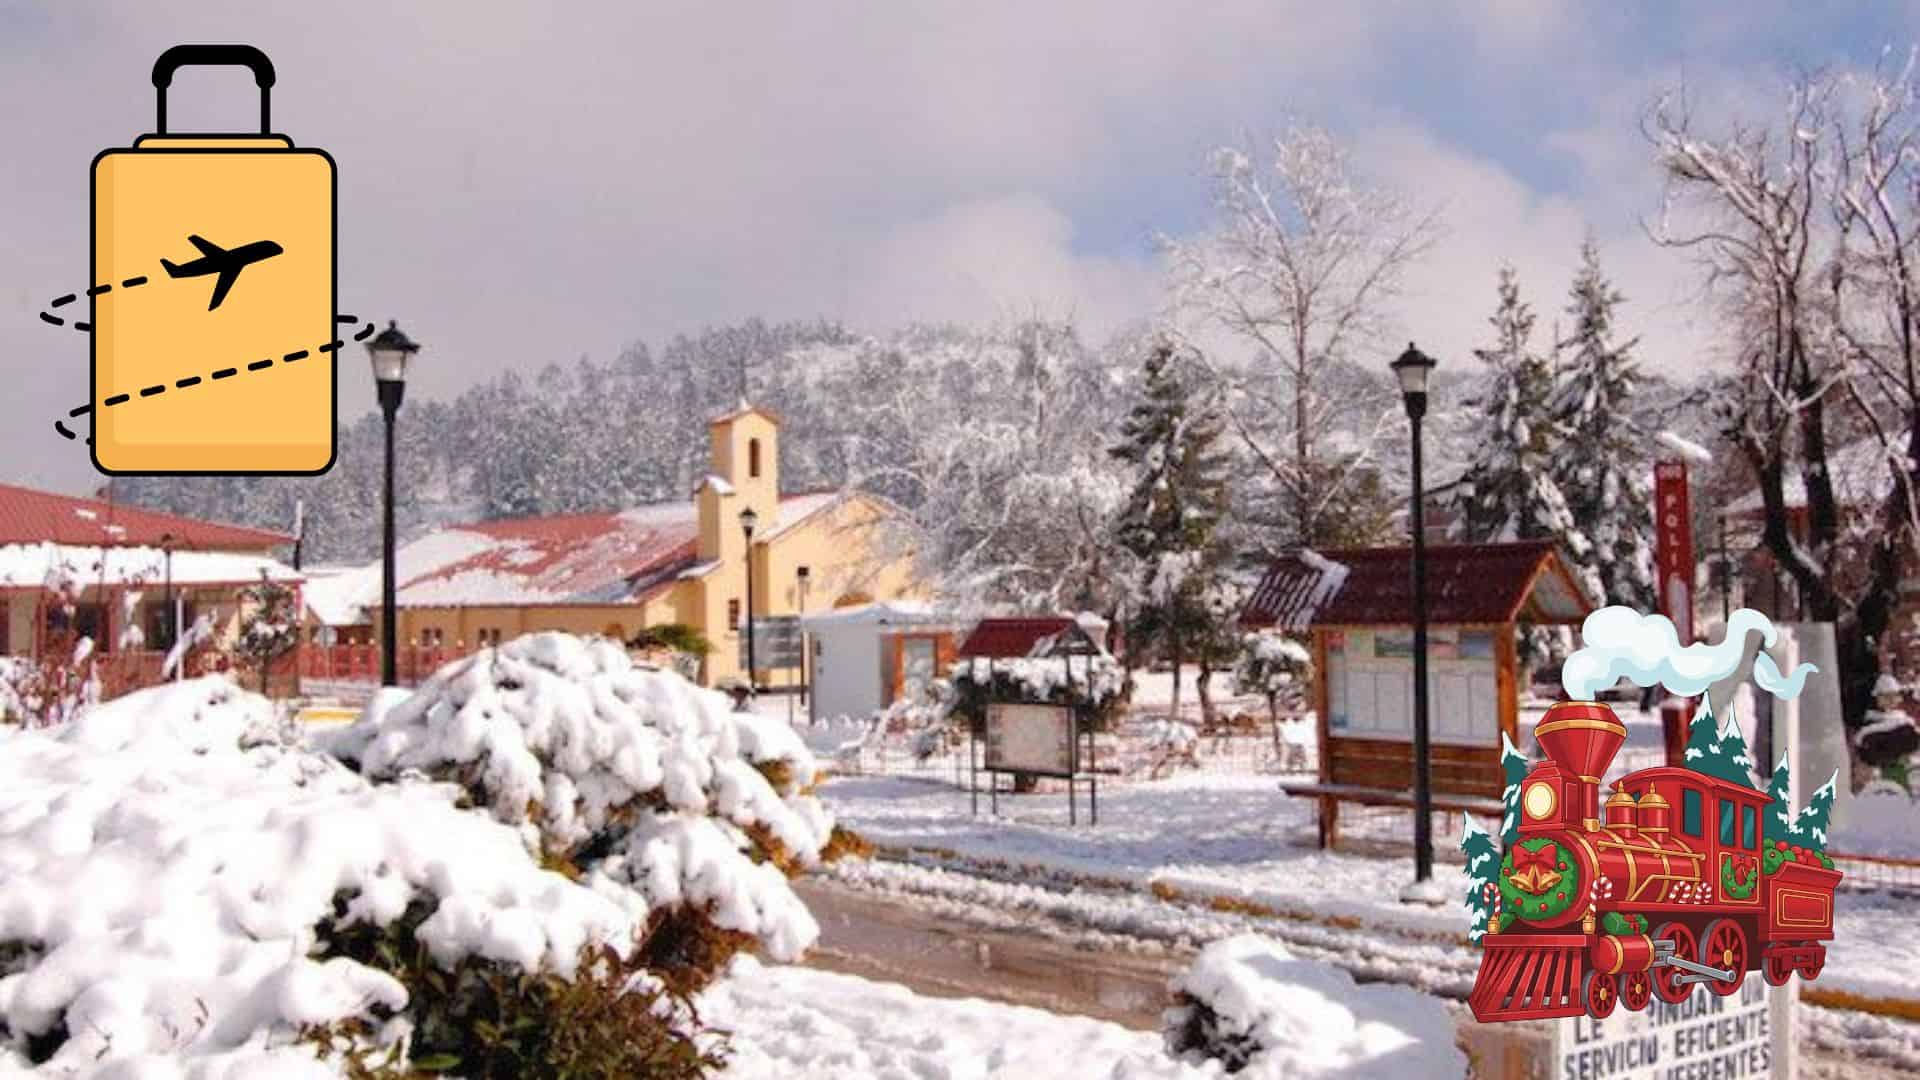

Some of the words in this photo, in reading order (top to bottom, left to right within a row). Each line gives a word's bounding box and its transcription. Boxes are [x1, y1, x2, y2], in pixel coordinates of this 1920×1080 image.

[1564, 1035, 1658, 1080] SERVICIO
[1674, 1007, 1768, 1058] EFICIENTE
[1574, 1017, 1604, 1045] LE
[1656, 1042, 1769, 1080] FERENTES
